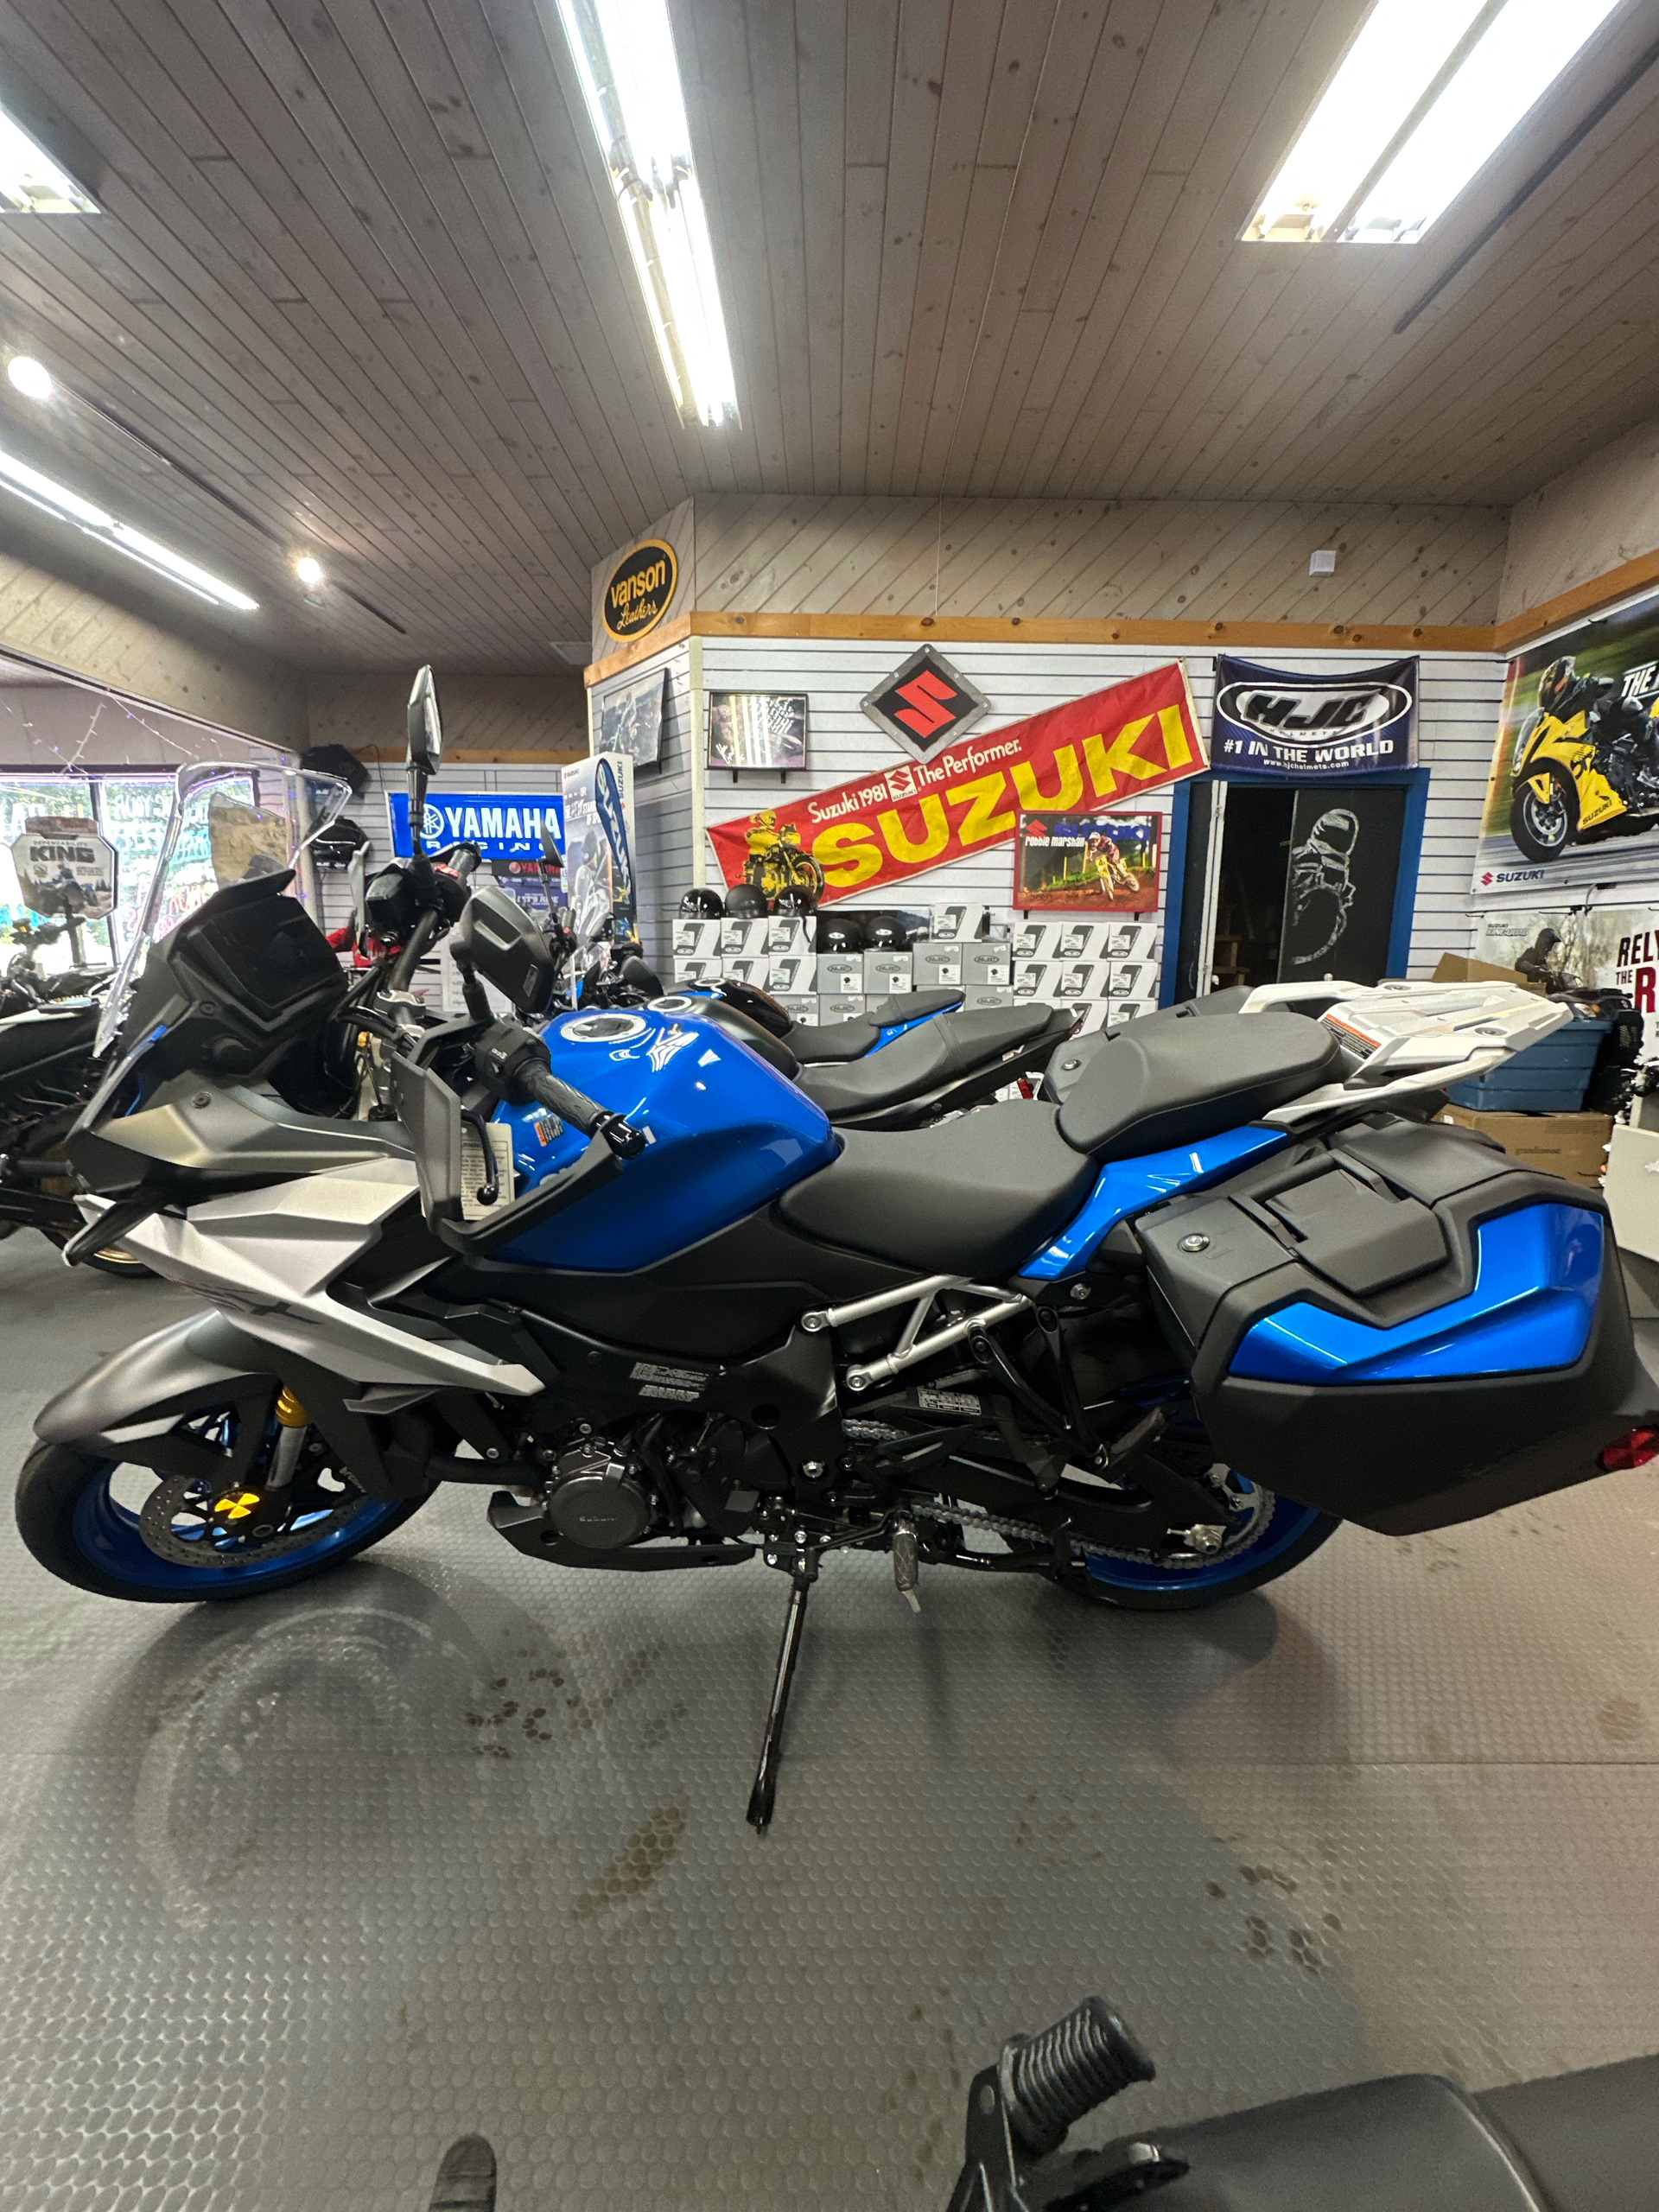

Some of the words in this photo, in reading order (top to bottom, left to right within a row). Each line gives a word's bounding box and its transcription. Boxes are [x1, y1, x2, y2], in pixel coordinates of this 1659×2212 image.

[611, 559, 666, 608] vanson
[616, 598, 658, 631] Leathers
[1621, 665, 1656, 697] THE
[1242, 689, 1382, 729] HJC
[1269, 728, 1340, 736] HELMETS
[1224, 739, 1243, 754] #1
[1248, 741, 1268, 757] IN
[1273, 746, 1308, 763] THE
[1314, 740, 1394, 763] WORLD
[1263, 759, 1350, 770] www.hjchelmets.com
[808, 791, 861, 823] Suzuki
[859, 783, 889, 807] 1981
[913, 765, 945, 787] The
[942, 738, 1022, 778] Performer.
[812, 703, 1193, 888] SUZUKI
[445, 807, 562, 839] YAMAHA
[1582, 799, 1613, 825] SUZUKI
[1025, 836, 1050, 848] robbie
[1051, 836, 1085, 848] marshall
[1054, 822, 1151, 841] SUZUKI
[29, 845, 96, 863] KING
[426, 841, 544, 851] RCIN
[1496, 869, 1546, 882] SUZUKI
[1616, 970, 1633, 985] THE
